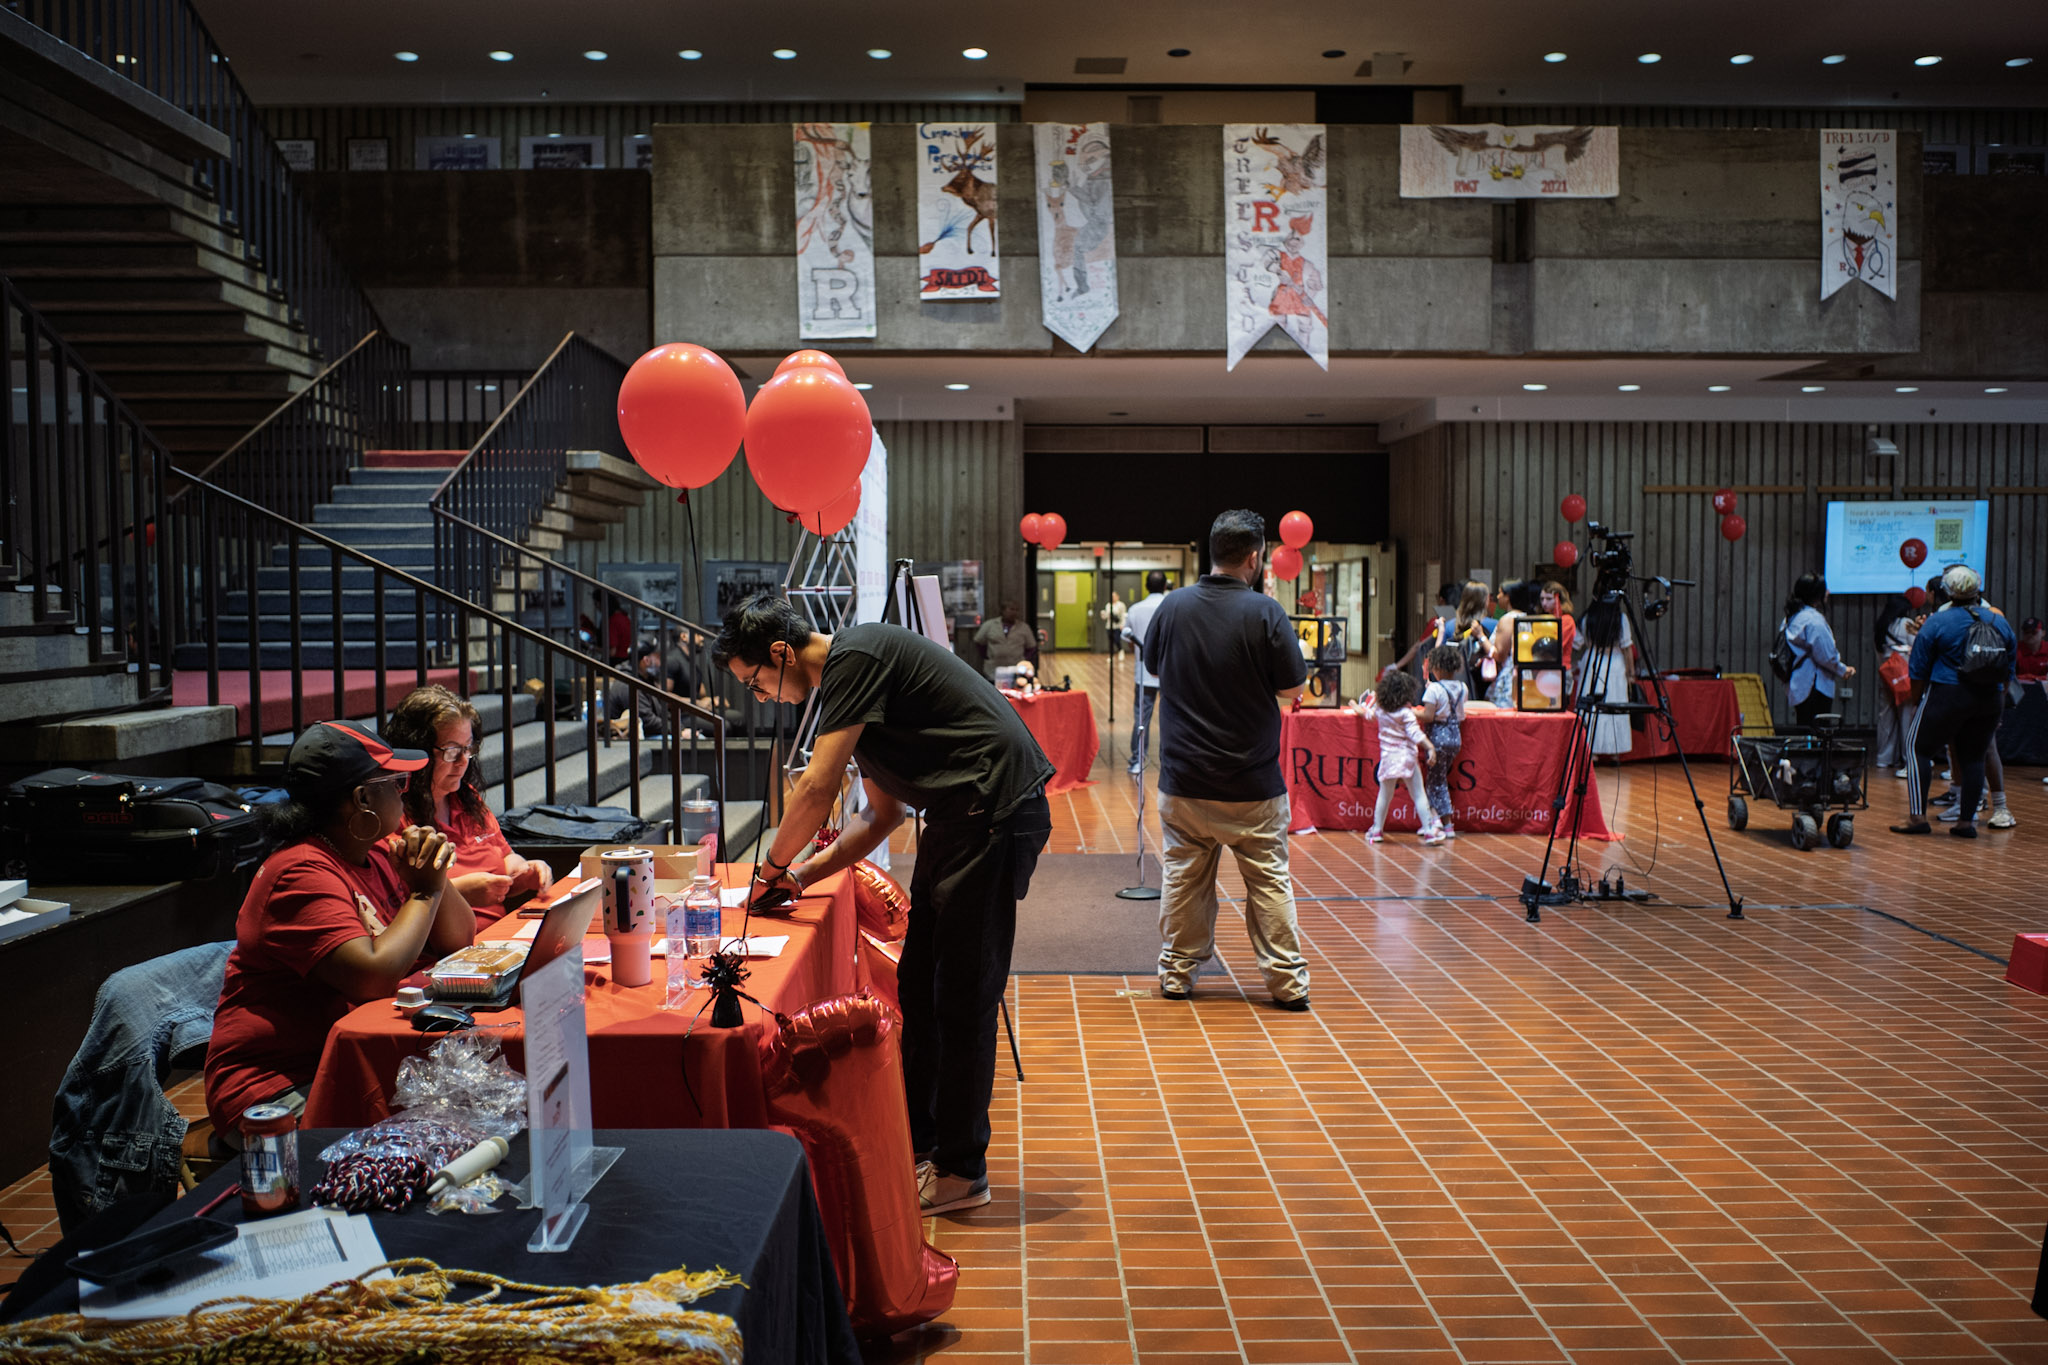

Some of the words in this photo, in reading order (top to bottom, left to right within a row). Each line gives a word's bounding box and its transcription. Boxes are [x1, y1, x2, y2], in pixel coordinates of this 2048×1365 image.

[1541, 180, 1568, 194] 2021
[1252, 201, 1280, 232] R
[1839, 262, 1847, 271] R
[812, 268, 862, 320] R
[1905, 546, 1918, 557] R
[1291, 747, 1478, 800] RUTS
[1393, 807, 1408, 819] of
[1467, 806, 1551, 822] Professions
